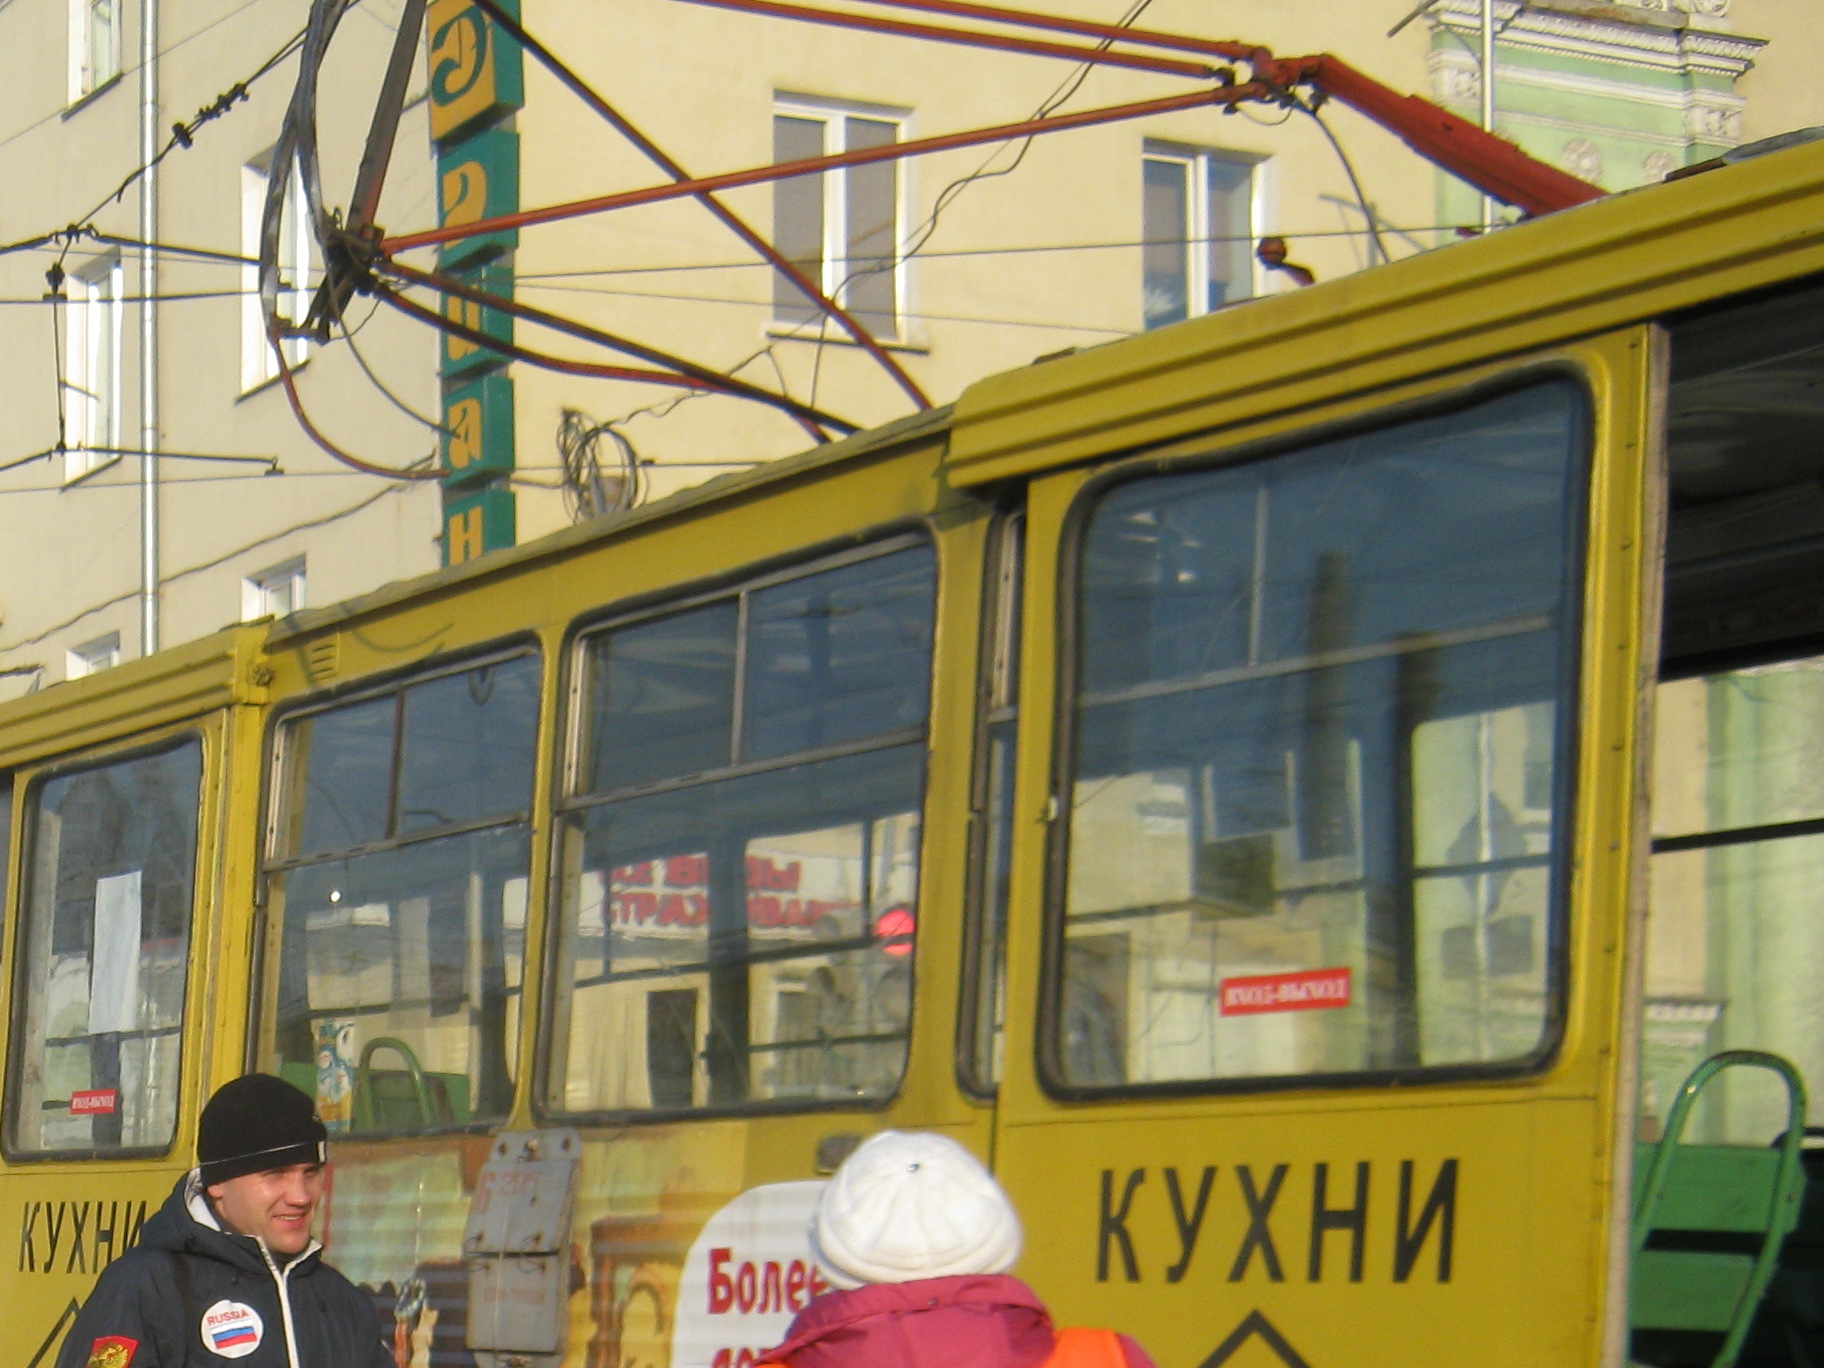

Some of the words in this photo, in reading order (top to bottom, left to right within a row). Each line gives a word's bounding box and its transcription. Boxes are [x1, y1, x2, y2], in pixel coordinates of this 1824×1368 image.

[19, 1201, 147, 1274] КУХНИ
[1096, 1157, 1460, 1284] КУХНИ
[206, 1308, 249, 1327] RUSSIA
